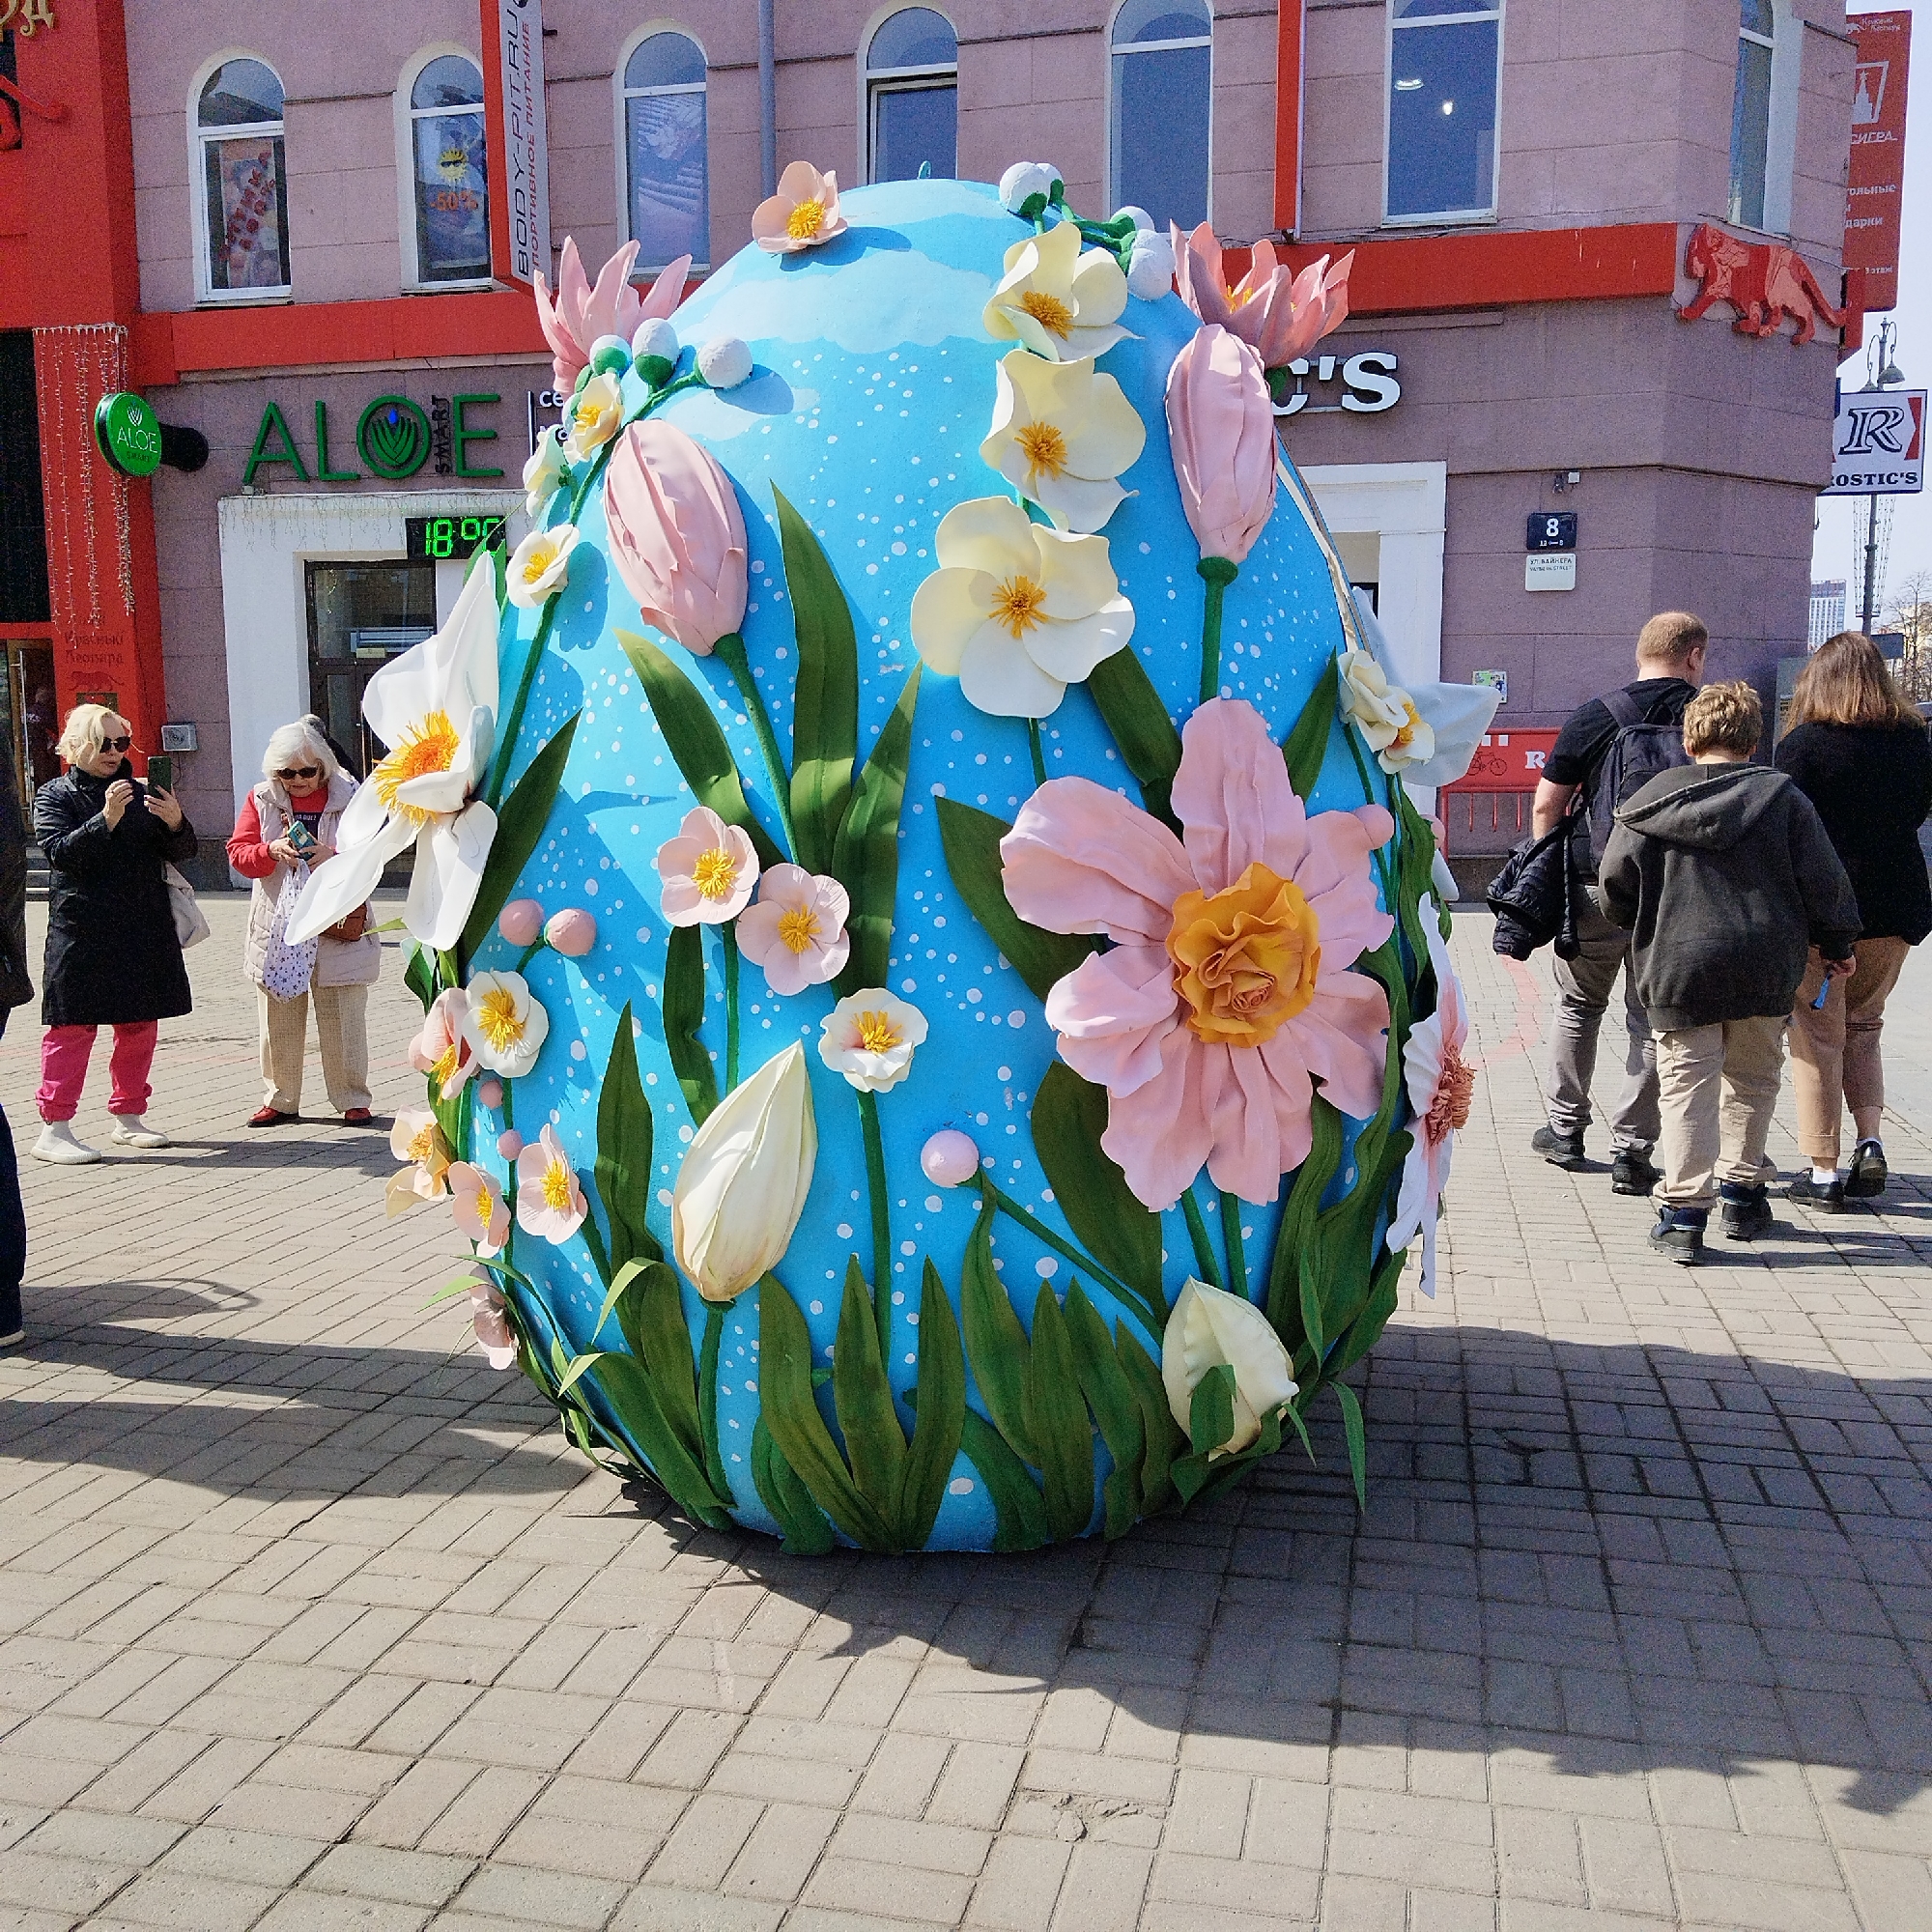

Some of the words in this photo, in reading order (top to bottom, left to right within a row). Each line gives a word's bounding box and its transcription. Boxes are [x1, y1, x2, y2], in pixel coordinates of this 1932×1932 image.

[522, 21, 533, 128] ПИТАНИЕ
[507, 8, 529, 277] BODY-PIT.RU
[526, 131, 540, 270] ПОРТИВНОЕ
[1845, 216, 1884, 229] дарки
[117, 425, 158, 454] ALOE
[242, 392, 504, 484] ALOE
[1838, 406, 1904, 456] R
[1546, 517, 1559, 537] 8
